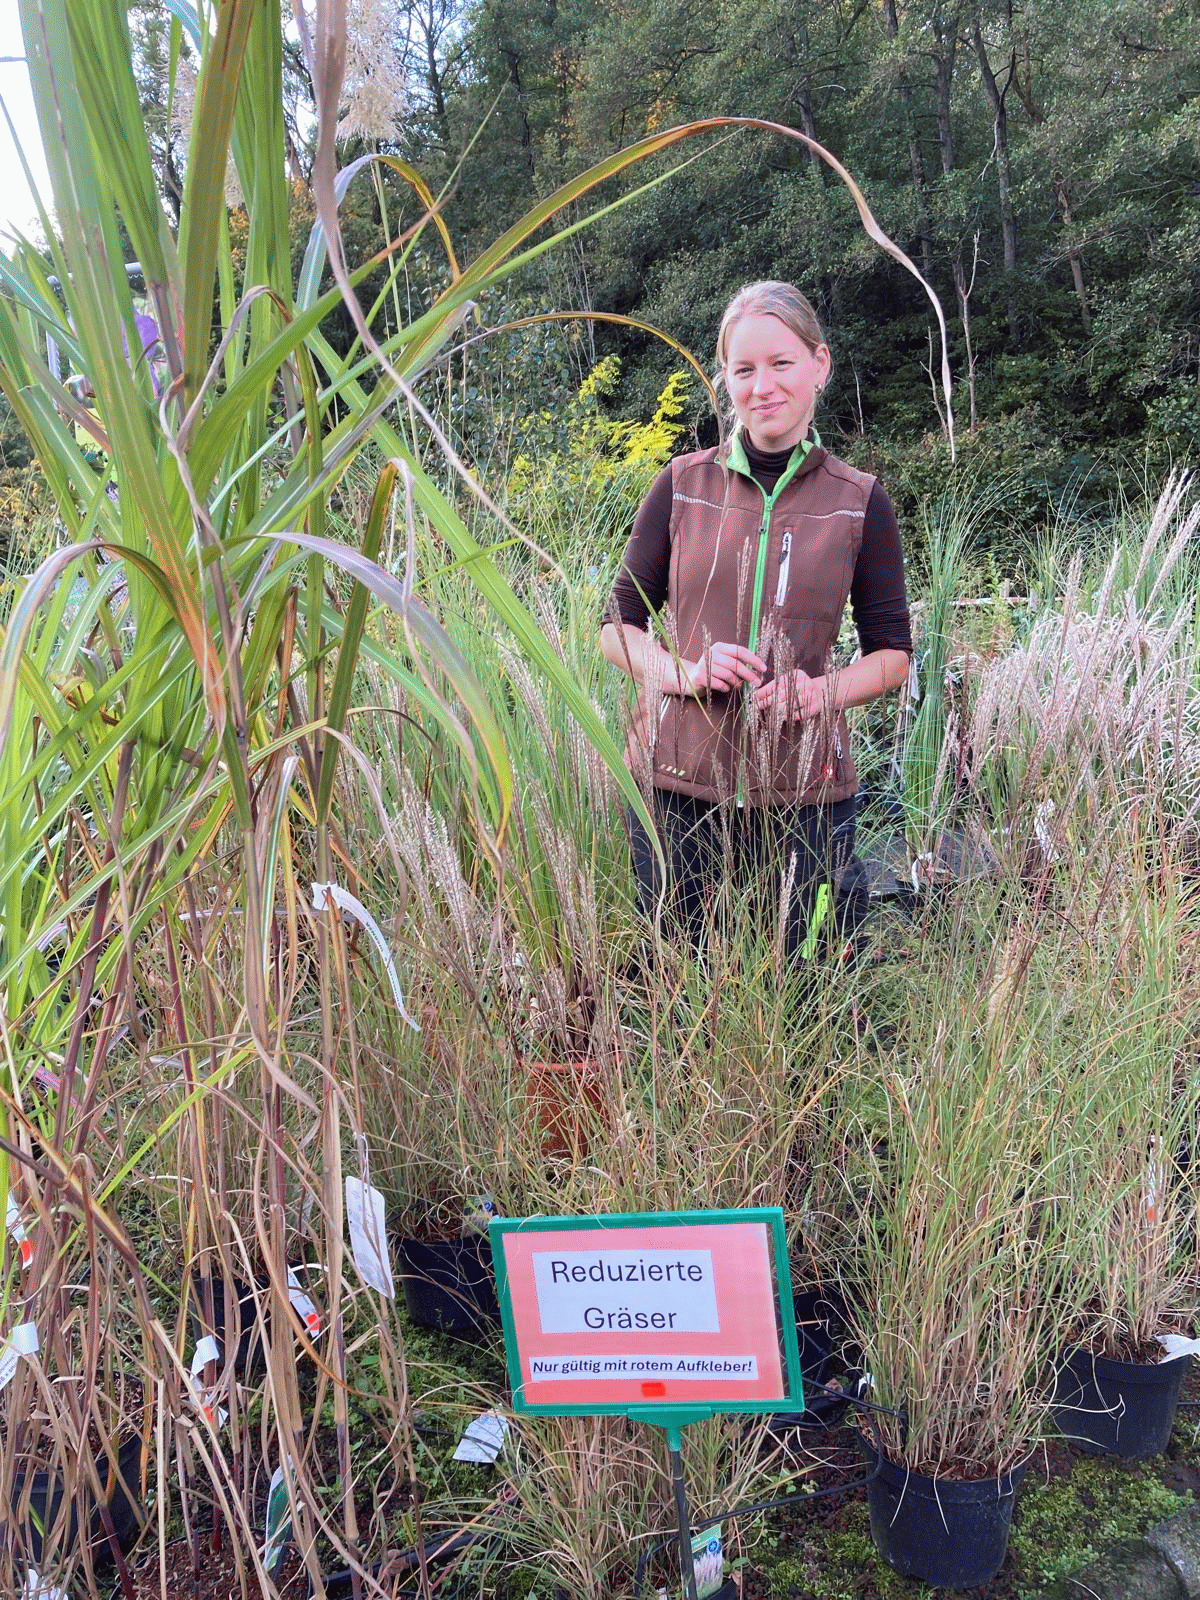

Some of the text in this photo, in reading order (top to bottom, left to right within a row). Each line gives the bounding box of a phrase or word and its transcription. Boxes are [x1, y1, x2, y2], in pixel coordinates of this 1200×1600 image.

[551, 1259, 703, 1284] Reduzierte
[583, 1307, 677, 1329] Gräser
[533, 1359, 752, 1375] Nur gültig mit rotem Aufkleber!
